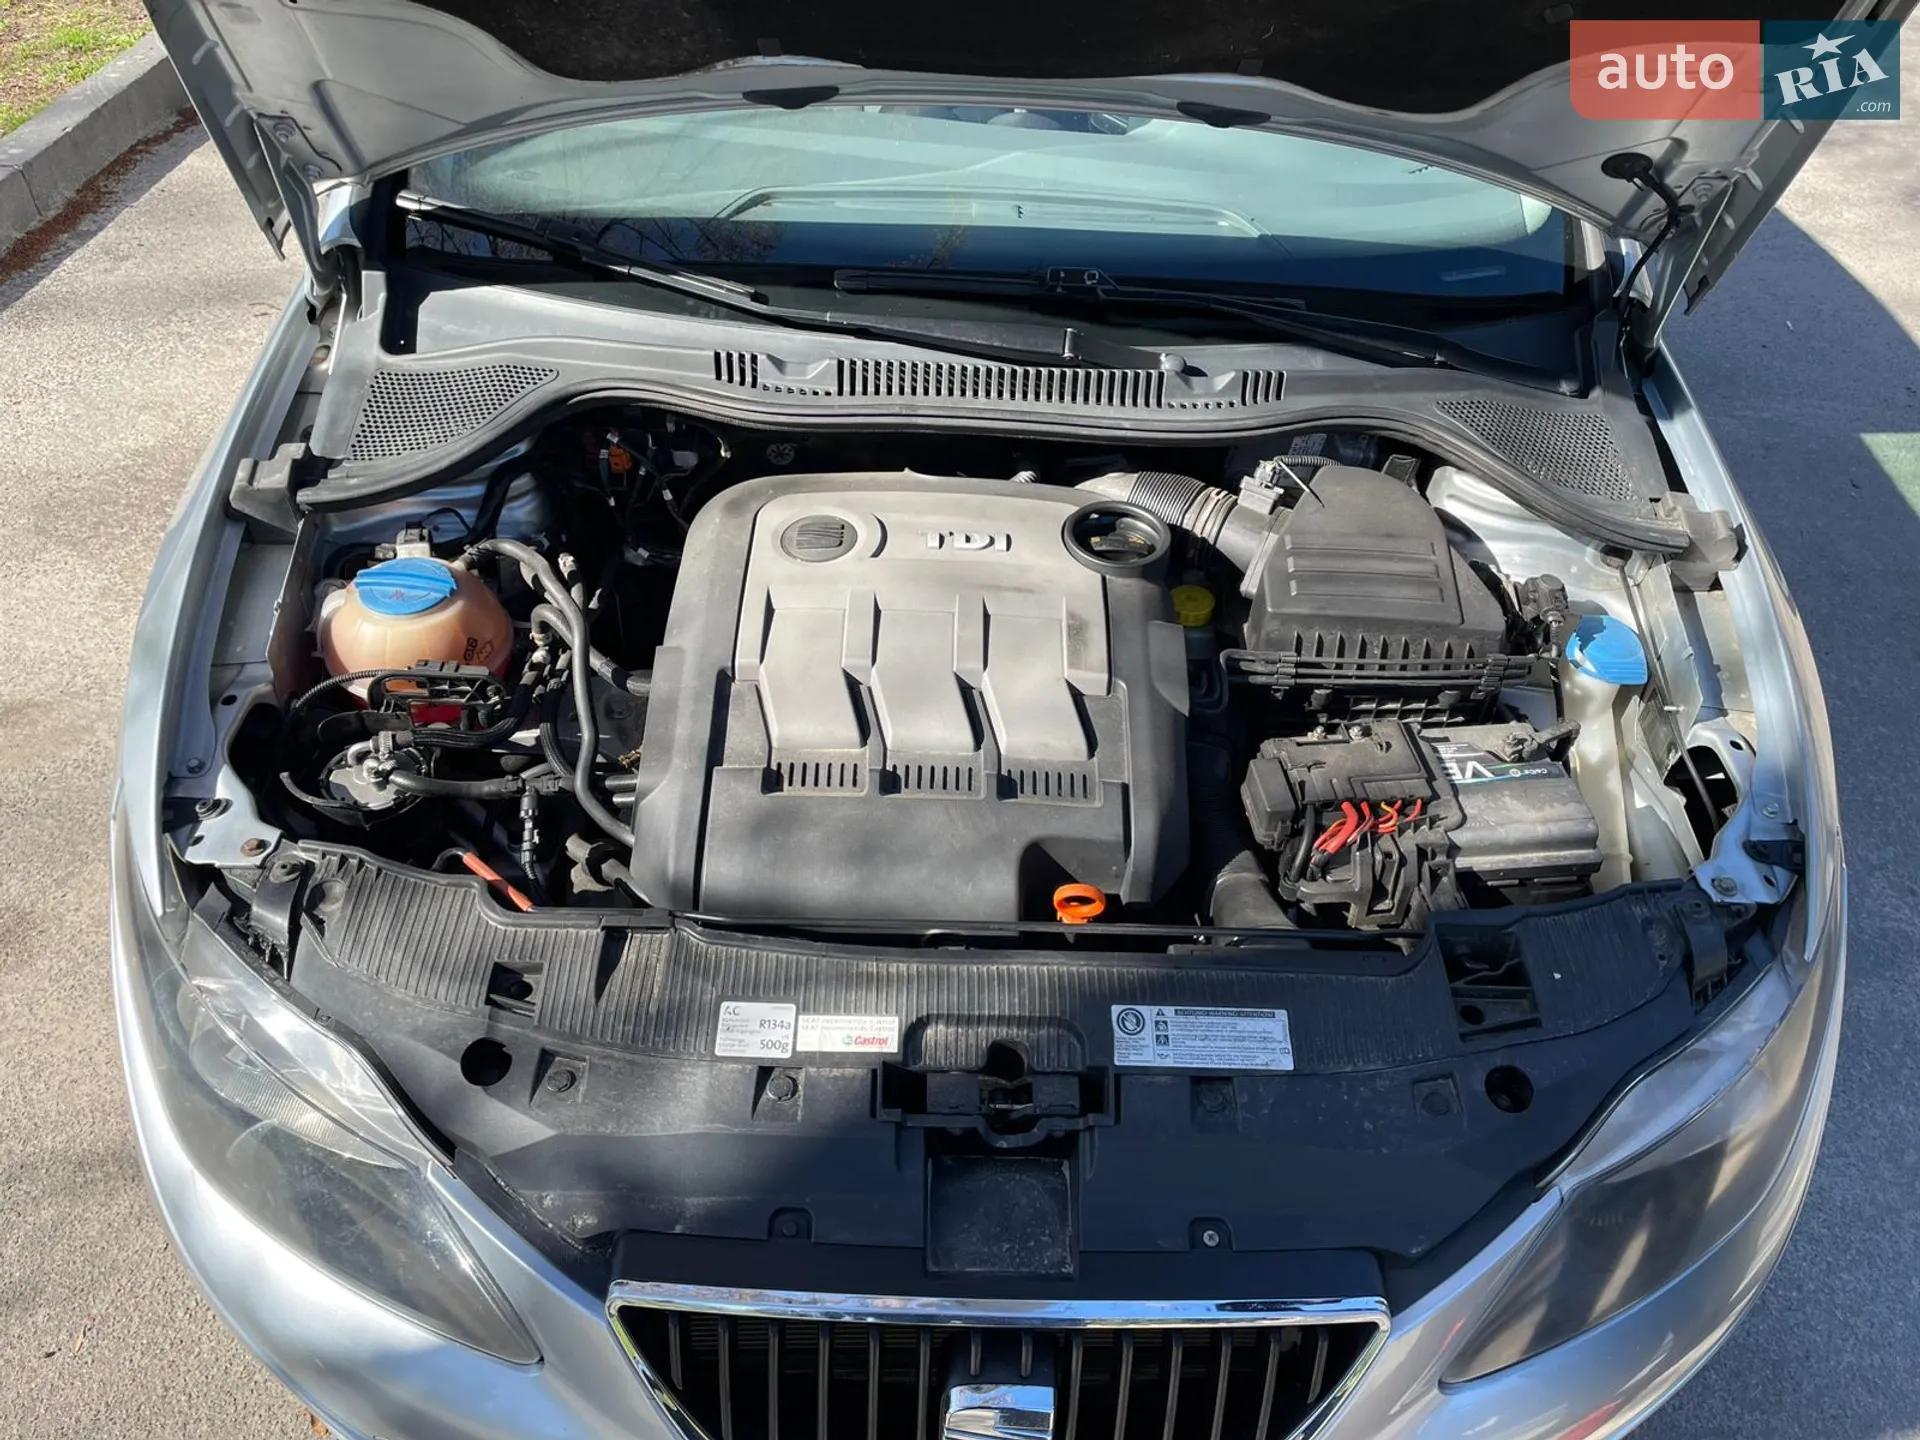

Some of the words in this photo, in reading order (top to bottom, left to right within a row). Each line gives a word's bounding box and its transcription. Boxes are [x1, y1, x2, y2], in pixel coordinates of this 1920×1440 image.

[917, 530, 1010, 553] TDI
[722, 1005, 741, 1017] AC
[758, 1018, 792, 1031] R134a
[759, 1038, 789, 1054] 500g
[854, 1035, 889, 1047] Castrol
